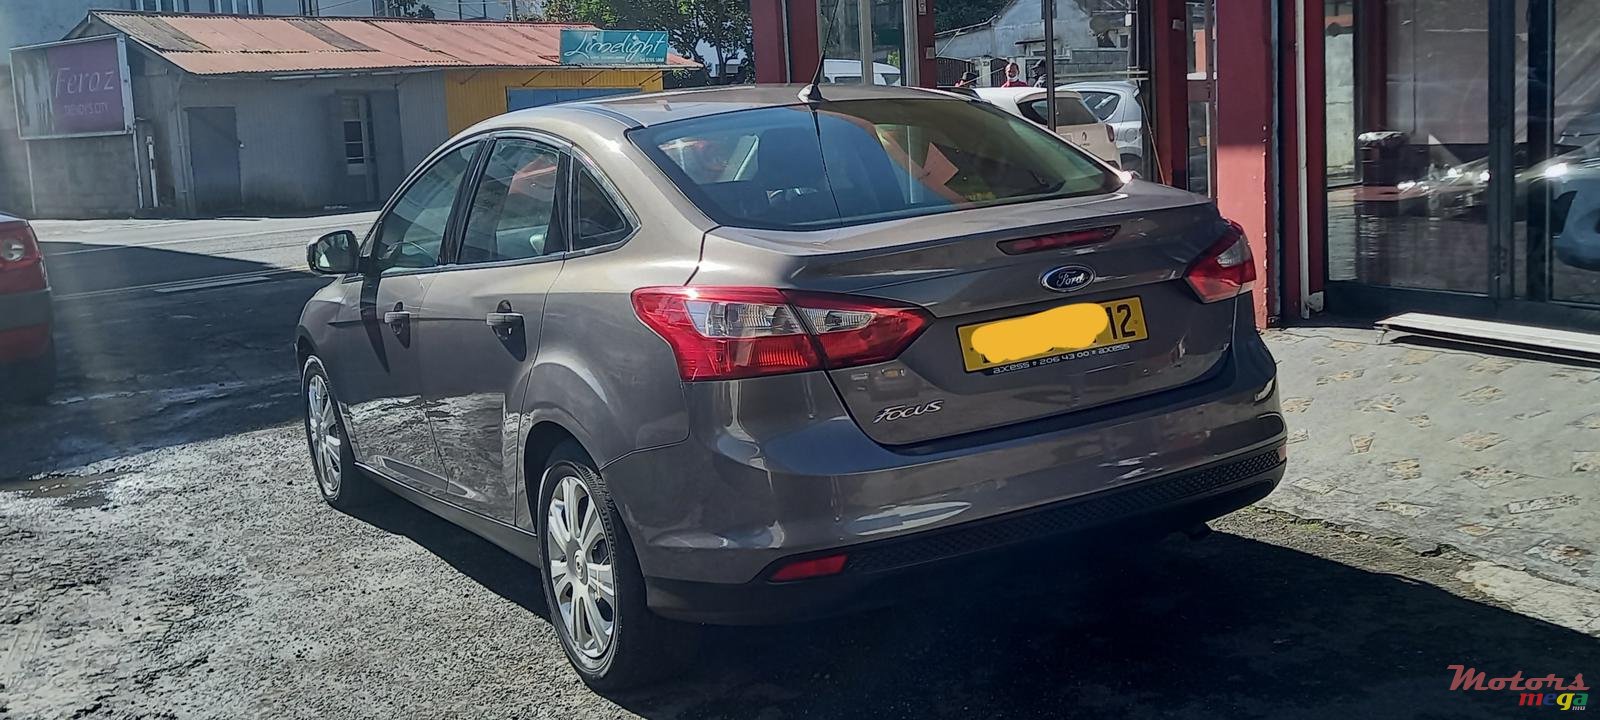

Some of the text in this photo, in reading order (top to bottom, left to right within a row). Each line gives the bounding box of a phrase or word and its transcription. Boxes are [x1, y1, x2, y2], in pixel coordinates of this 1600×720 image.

[564, 32, 666, 62] Limelight
[55, 67, 115, 98] Feroz
[1056, 270, 1087, 287] Ford
[993, 361, 1030, 374] axess
[1039, 356, 1061, 366] 206
[1061, 353, 1075, 361] 43
